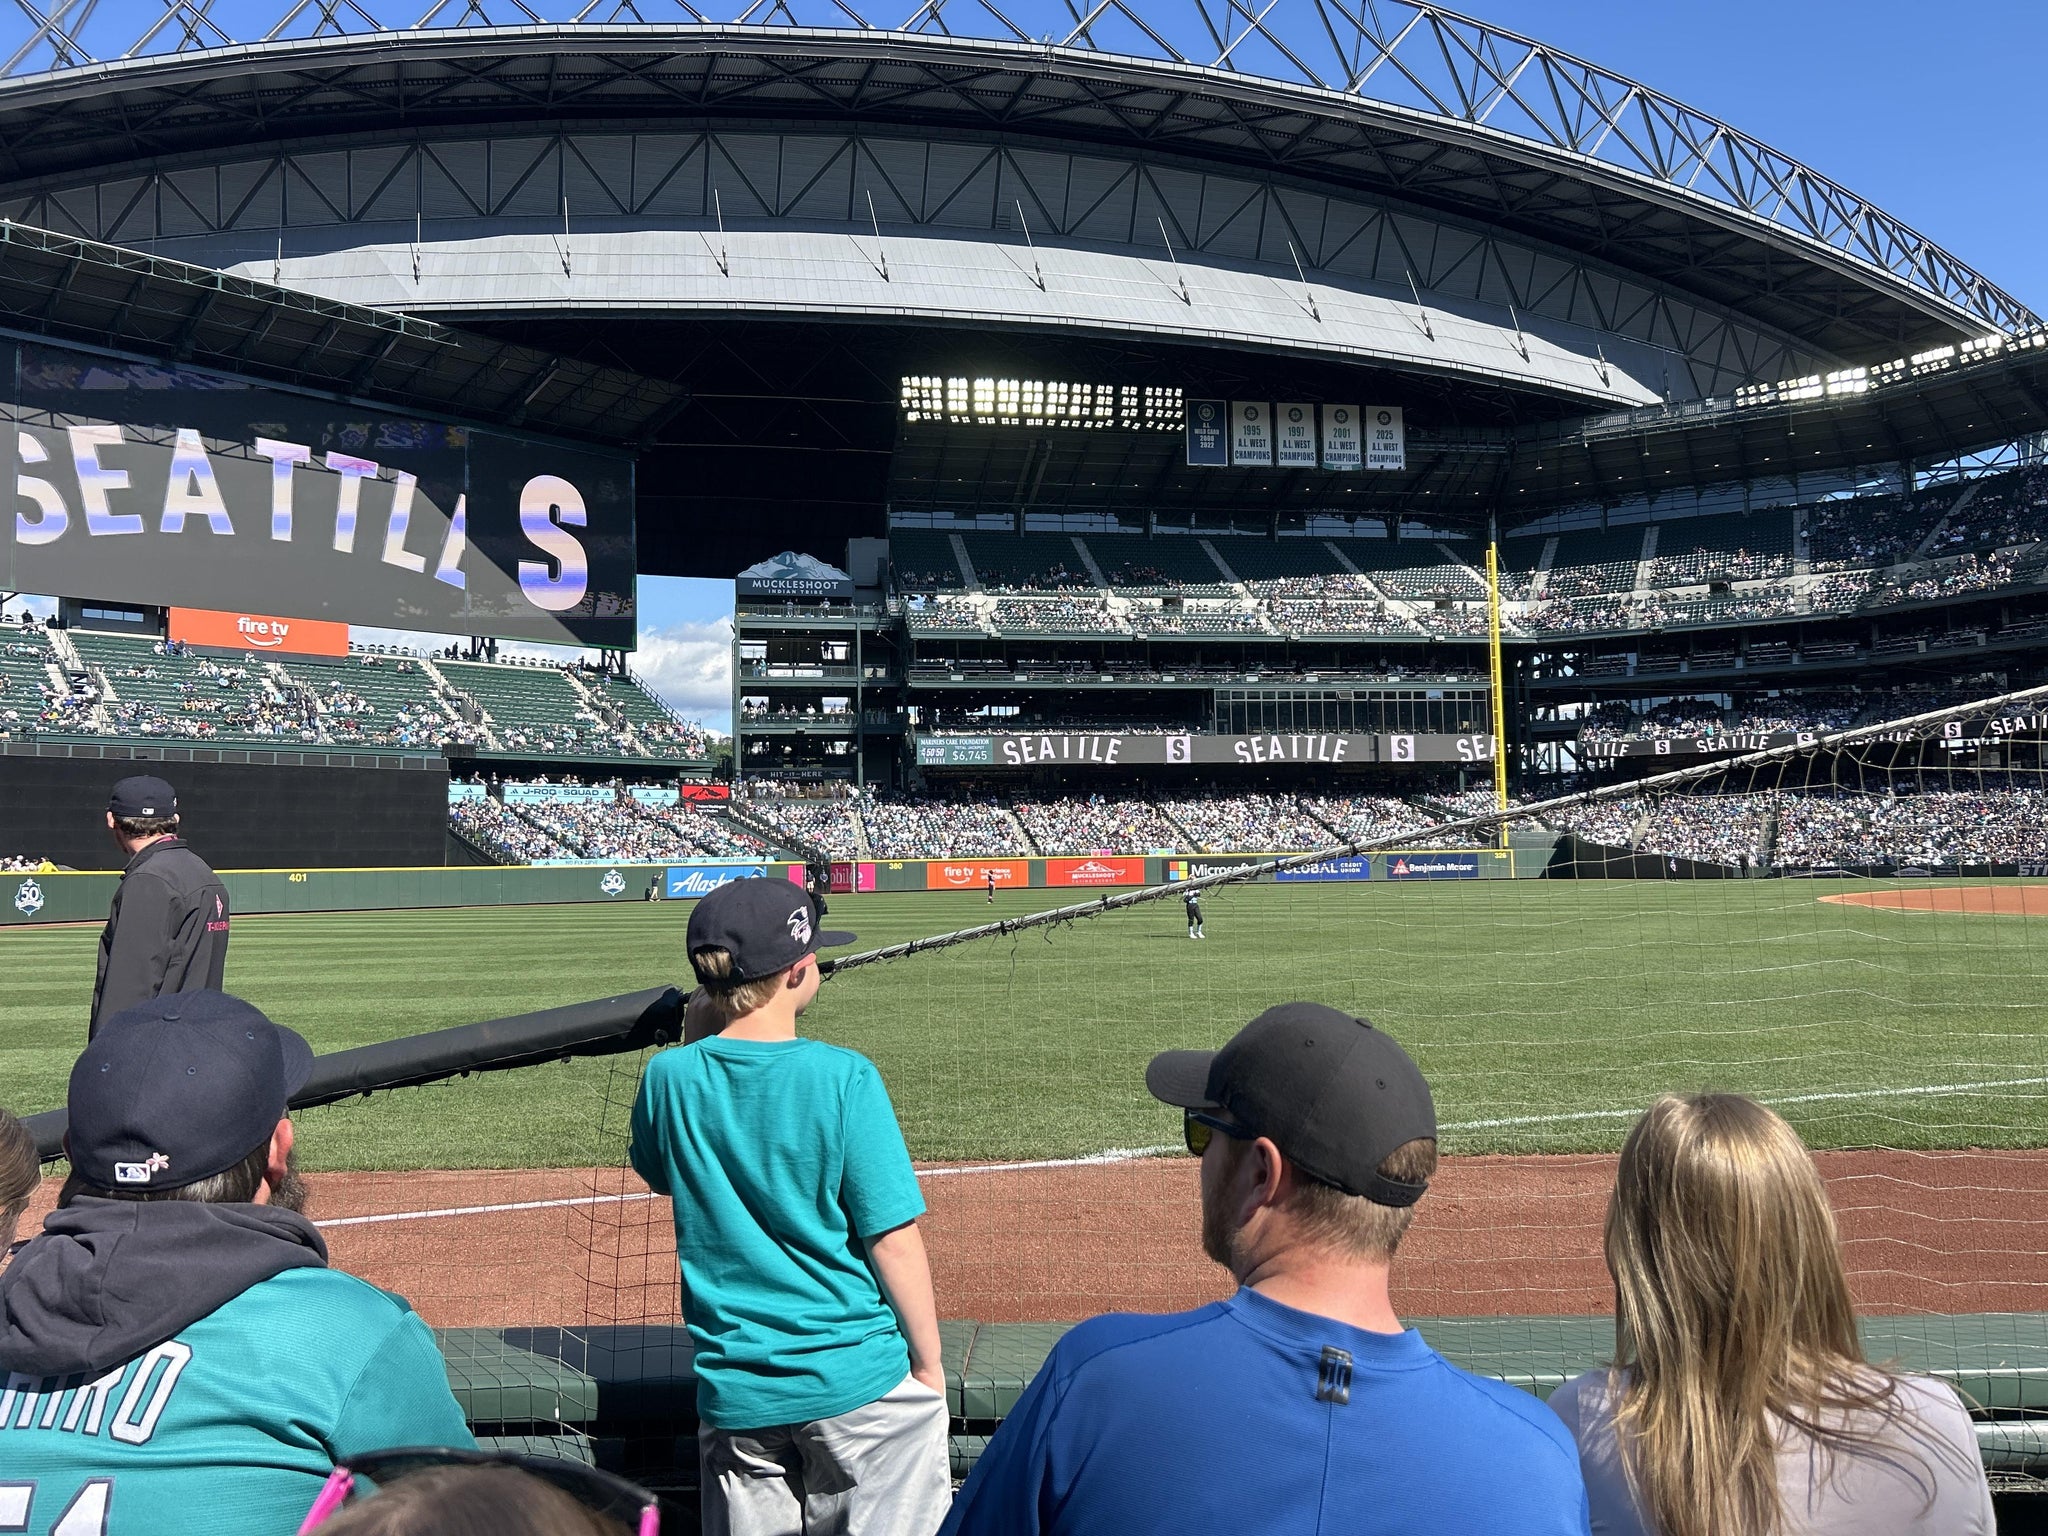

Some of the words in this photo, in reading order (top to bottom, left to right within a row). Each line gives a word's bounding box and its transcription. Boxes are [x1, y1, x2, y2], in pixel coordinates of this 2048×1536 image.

[1243, 425, 1261, 436] 1995
[1288, 427, 1304, 437] 1997
[1333, 428, 1351, 438] 2001
[1376, 430, 1394, 440] 2025
[1249, 439, 1266, 448] WEST
[1296, 440, 1311, 449] WEST
[1341, 442, 1356, 451] WEST
[1385, 443, 1398, 452] WEST
[1235, 450, 1271, 460] CHAMPIONS
[1279, 452, 1315, 461] CHAMPIONS
[1325, 453, 1360, 462] CHAMPIONS
[1369, 454, 1402, 464] CHAMPIONS
[518, 474, 588, 611] S
[752, 580, 839, 589] MUCKLESHOOT
[237, 617, 269, 634] fire
[271, 621, 289, 636] tv
[1949, 723, 1958, 736] S
[1234, 735, 1349, 763] SEATTLE
[1397, 738, 1409, 759] S
[1658, 742, 1667, 754] S
[1696, 735, 1770, 753] SEATTLE
[952, 750, 988, 760] $6,745
[1003, 736, 1122, 765] SEATTLE
[1173, 739, 1184, 760] S
[523, 788, 556, 796] J-ROD
[889, 862, 903, 870] 380
[944, 866, 962, 876] fire
[963, 867, 974, 876] tv
[1409, 863, 1446, 873] Benjamin
[288, 873, 307, 882] 401
[606, 875, 621, 885] 50
[21, 886, 40, 901] 50
